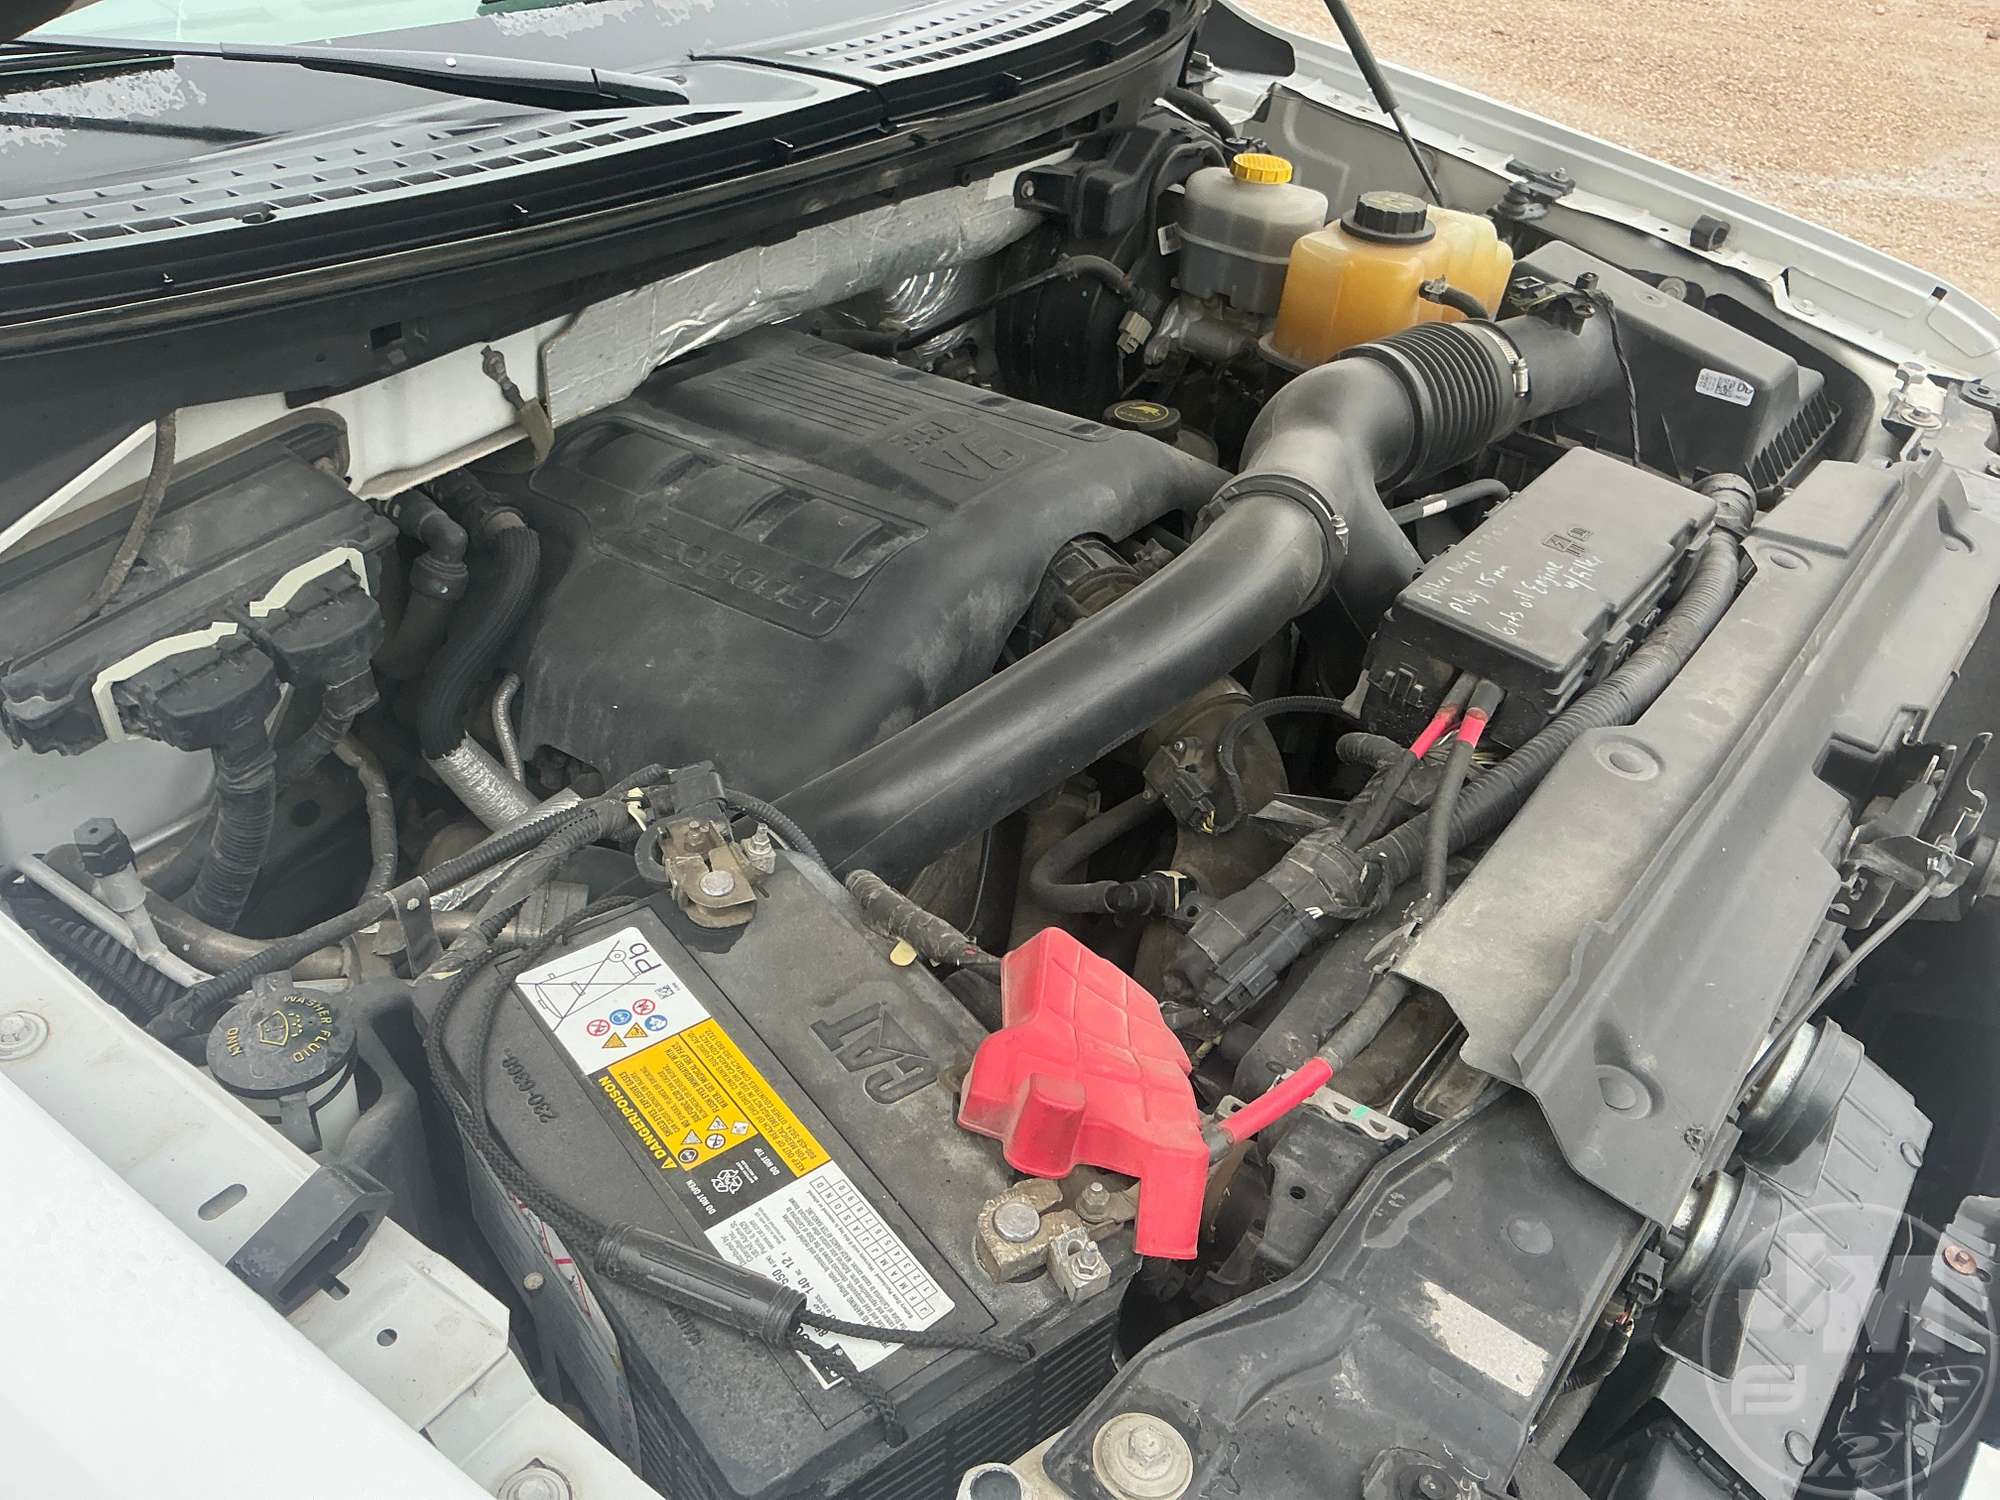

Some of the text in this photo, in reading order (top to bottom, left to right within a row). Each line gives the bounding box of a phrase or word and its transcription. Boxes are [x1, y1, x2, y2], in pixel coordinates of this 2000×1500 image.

[621, 940, 662, 974] Pb
[283, 993, 333, 1063] WASHER FLUID
[225, 1026, 243, 1058] ONLY
[807, 1001, 940, 1105] CAT
[597, 1074, 669, 1159] DANGER/POISON
[759, 1154, 774, 1168] NOT
[768, 1164, 781, 1176] DO
[695, 1192, 711, 1207] NOT
[704, 1203, 717, 1215] DO
[779, 1255, 796, 1270] 12
[770, 1267, 790, 1286] 550
[795, 1275, 815, 1295] 140
